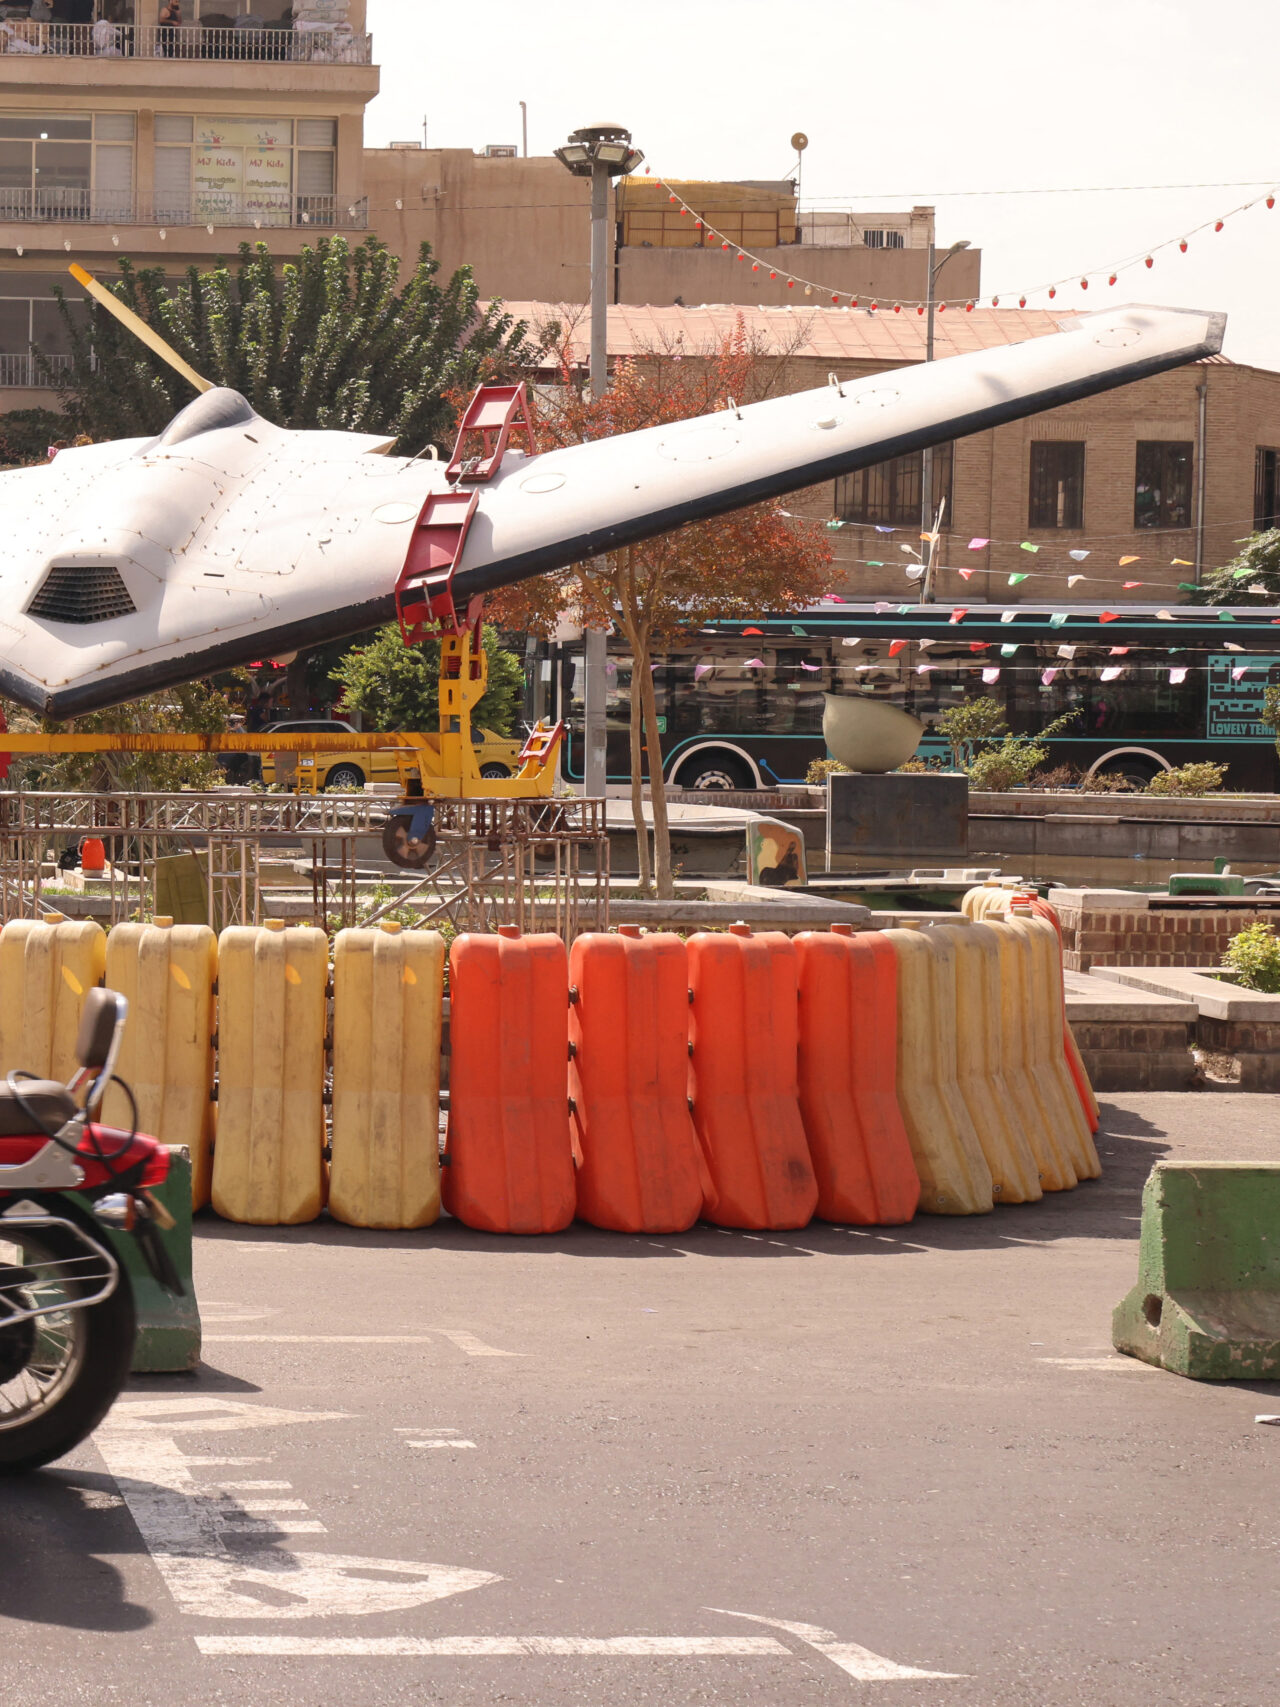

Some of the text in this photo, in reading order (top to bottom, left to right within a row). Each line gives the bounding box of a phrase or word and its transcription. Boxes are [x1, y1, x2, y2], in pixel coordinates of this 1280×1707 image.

[197, 158, 236, 166] MJ Kids
[267, 160, 284, 168] Kids
[1211, 723, 1247, 735] LOVELY
